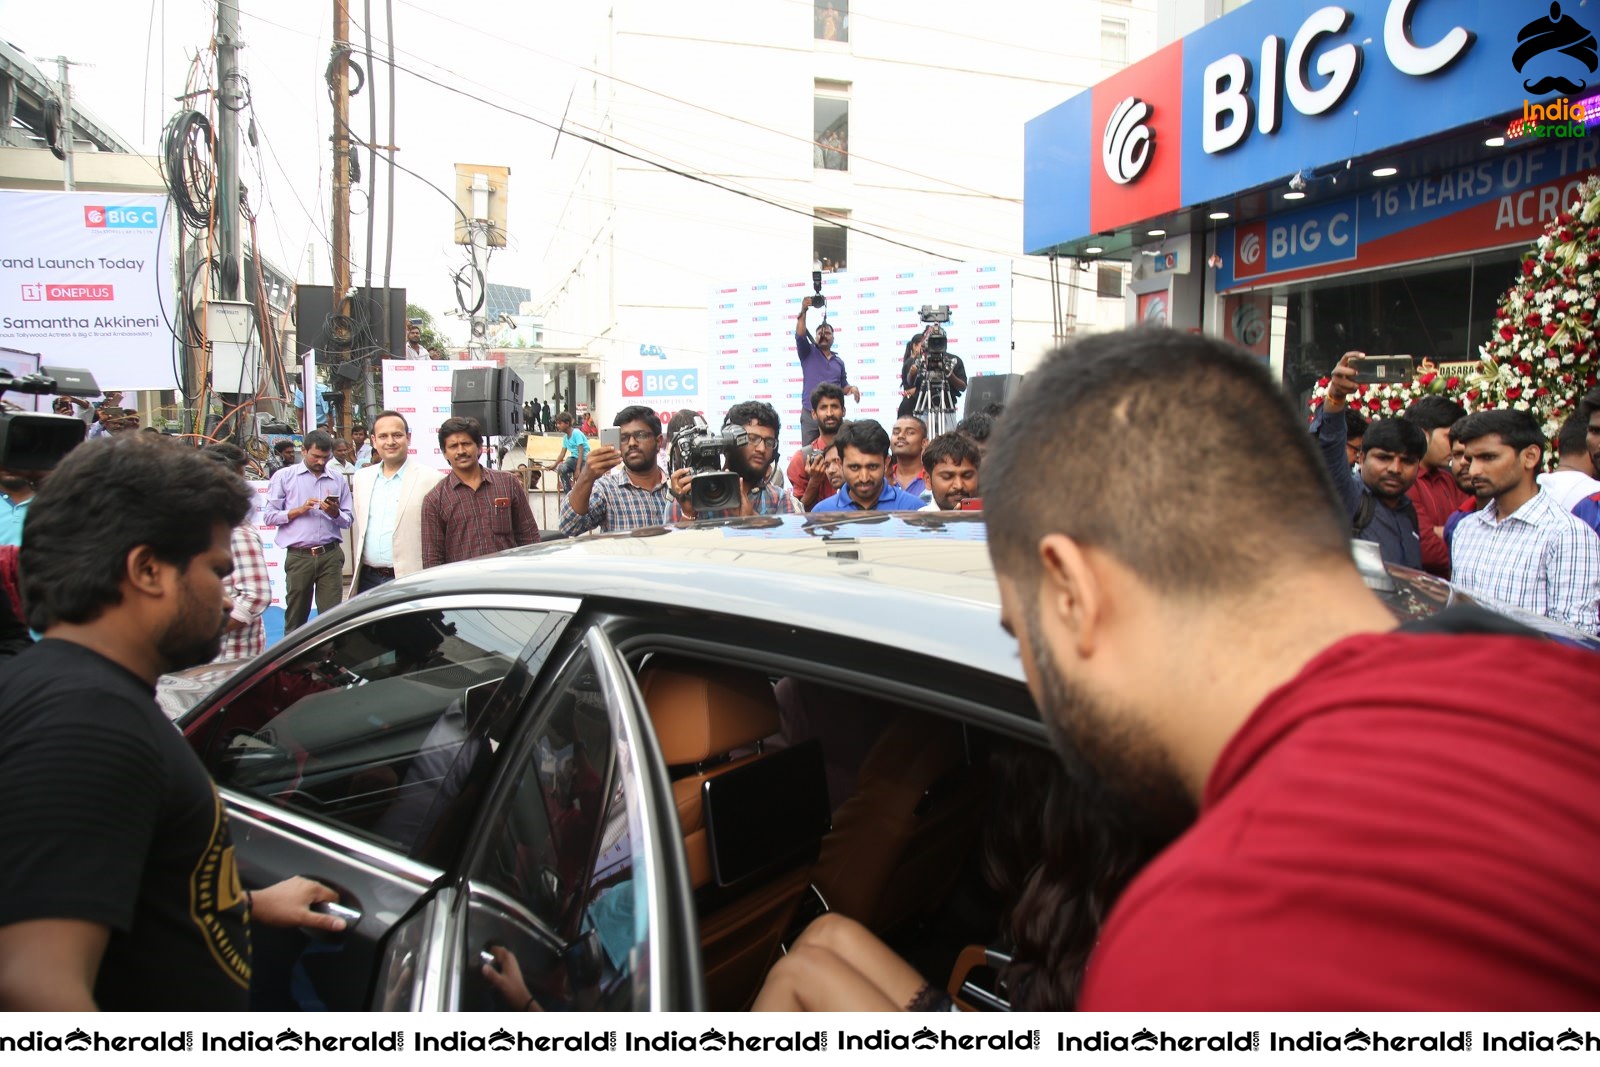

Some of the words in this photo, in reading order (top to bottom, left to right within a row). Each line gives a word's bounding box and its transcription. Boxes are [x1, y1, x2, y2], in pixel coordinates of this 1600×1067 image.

[1203, 6, 1364, 154] BIG
[1384, 0, 1477, 76] C
[1372, 187, 1400, 218] 16
[1407, 163, 1492, 210] YEARS
[1502, 149, 1546, 188] OF
[108, 210, 139, 224] BIG
[141, 211, 154, 224] C
[1271, 219, 1321, 259] BIG
[1327, 212, 1349, 246] C
[0, 257, 34, 269] and
[38, 257, 95, 269] Launch
[97, 258, 145, 273] Today
[51, 287, 110, 298] ONEPLUS
[3, 316, 89, 329] Samantha
[94, 315, 160, 328] Akkineni
[645, 374, 679, 391] BIG
[681, 374, 695, 390] C
